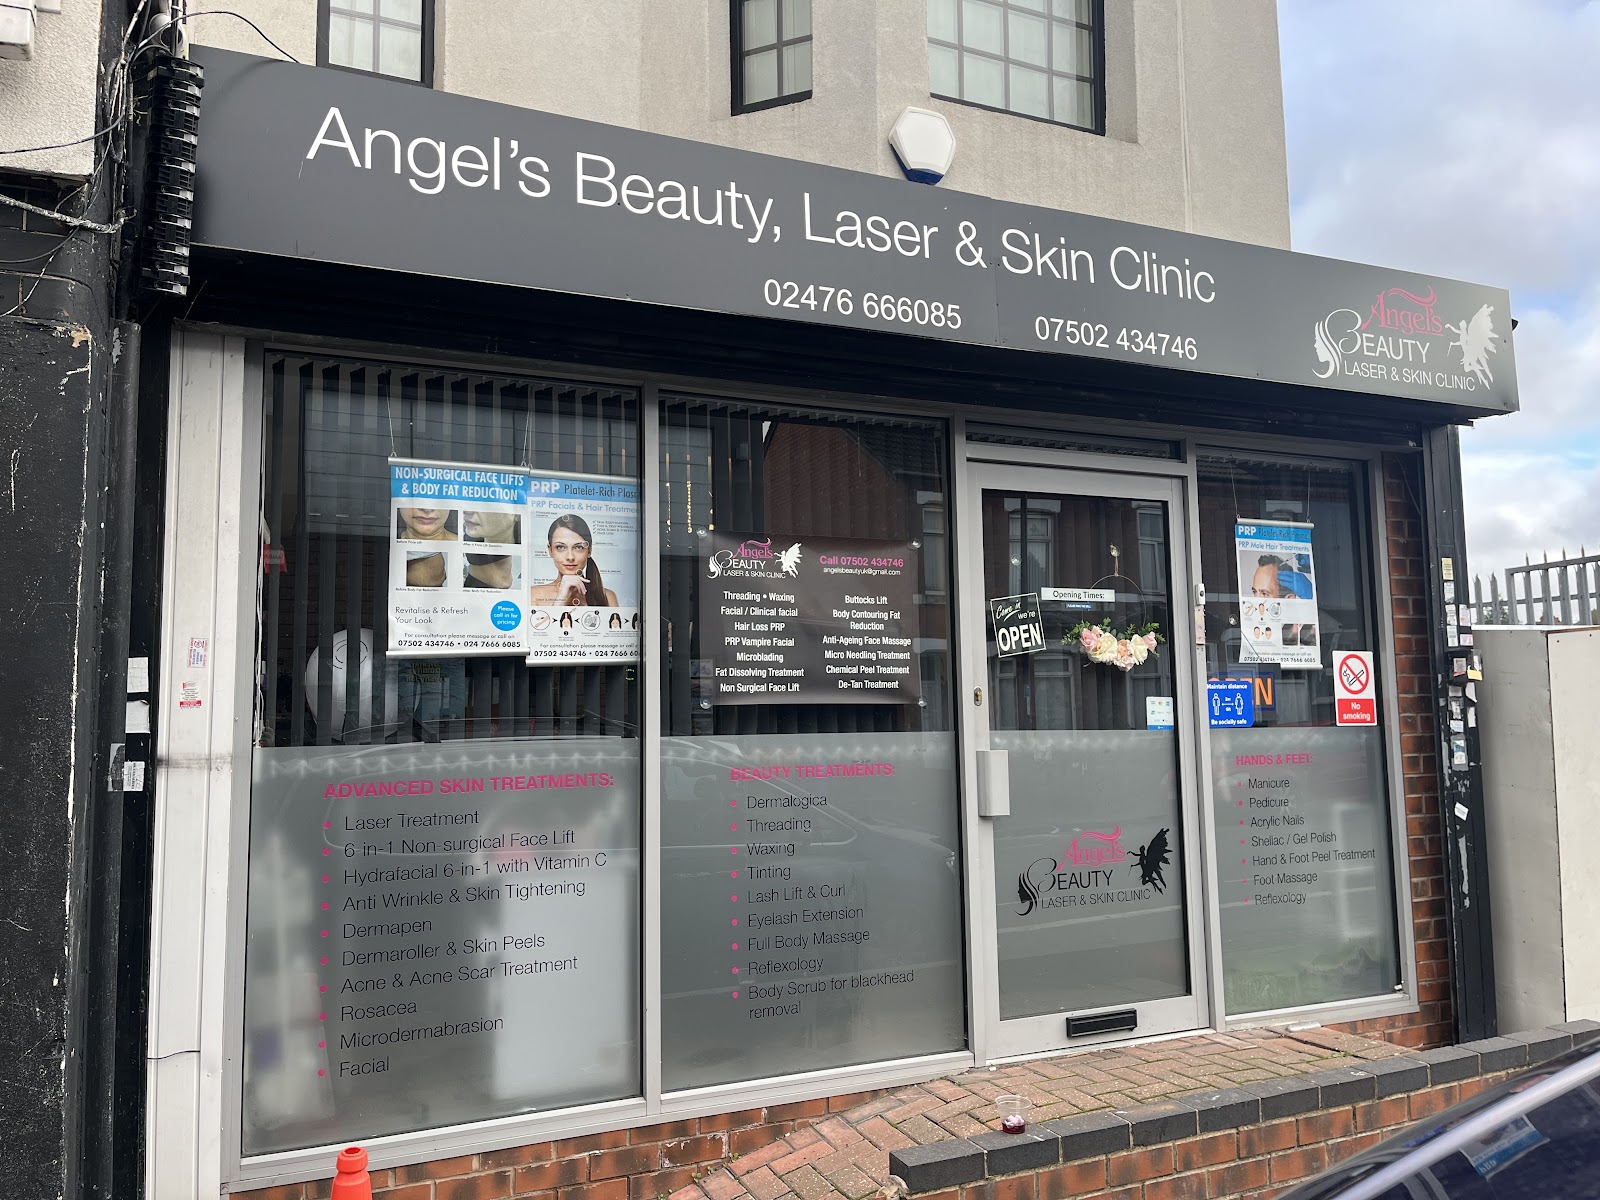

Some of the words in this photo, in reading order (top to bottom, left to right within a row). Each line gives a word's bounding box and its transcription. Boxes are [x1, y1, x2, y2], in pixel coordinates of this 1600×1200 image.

[305, 106, 551, 196] Angel's
[575, 151, 781, 244] Beauty,
[803, 192, 939, 260] Laser
[955, 220, 988, 269] &
[1001, 227, 1096, 284] Skin
[1109, 245, 1216, 304] Clinic
[763, 278, 854, 315] 02476
[862, 291, 963, 330] 666085
[1034, 315, 1110, 349] 07502
[1115, 327, 1198, 361] 434746
[1344, 360, 1387, 380] LASER
[1391, 367, 1400, 381] &
[1402, 369, 1432, 386] SKIN
[1436, 372, 1475, 391] CLINIC
[395, 467, 472, 482] NON-SURGICAL
[475, 471, 497, 483] FACE
[501, 473, 524, 486] LIFTS
[413, 483, 440, 495] BODY
[443, 485, 459, 496] FAT
[462, 486, 518, 500] REDUCTION
[530, 481, 560, 493] PRP
[564, 484, 615, 497] Platelet-Rich
[1238, 526, 1256, 535] PRP
[819, 556, 838, 565] Call
[841, 556, 868, 566] 07502
[871, 557, 904, 567] 434746
[823, 567, 901, 576] angelsbeautyuk@gmail.com
[723, 591, 761, 602] Threading
[769, 592, 794, 603] Waxing
[845, 595, 875, 604] Buttocks
[876, 596, 888, 605] Lift
[1053, 591, 1081, 599] Opening
[1083, 591, 1104, 599] Times:
[441, 607, 468, 615] Refresh
[720, 606, 743, 615] Facial
[750, 607, 776, 616] Clinical
[778, 608, 798, 617] facial
[833, 610, 850, 620] Body
[851, 610, 888, 621] Contouring
[890, 611, 900, 620] Fat
[996, 605, 1013, 619] Come
[1015, 600, 1021, 609] in
[1018, 610, 1035, 619] we're
[734, 622, 750, 631] Hair
[751, 622, 768, 631] Loss
[770, 623, 785, 631] PRP
[850, 622, 884, 630] Reduction
[725, 637, 740, 646] PRP
[741, 638, 771, 648] Vampire
[773, 638, 794, 647] Facial
[823, 636, 863, 646] Anti-Ageing
[864, 636, 881, 645] Face
[883, 637, 911, 647] Massage
[998, 623, 1042, 651] OPEN
[736, 653, 784, 663] Microblading
[825, 651, 845, 660] Micro
[846, 651, 876, 661] Needling
[878, 651, 910, 660] Treatment
[715, 668, 727, 676] Fat
[729, 668, 767, 678] Dissolving
[768, 668, 804, 677] Treatment
[826, 665, 858, 674] Chemical
[860, 666, 875, 674] Peel
[877, 666, 909, 674] Treatment
[720, 683, 735, 692] Non
[737, 683, 767, 693] Surgical
[769, 683, 786, 692] Face
[787, 683, 800, 692] Lift
[838, 680, 863, 689] De-Tan
[865, 680, 899, 689] Treatment
[1351, 702, 1360, 710] No
[1343, 712, 1370, 722] smoking
[1236, 754, 1273, 766] HANDS
[1286, 753, 1313, 764] FEET:
[730, 766, 792, 781] BEAUTY
[796, 763, 896, 778] TREATMENTS:
[323, 780, 434, 799] ADVANCED
[439, 778, 485, 795] SKIN
[490, 773, 614, 792] TREATMENTS:
[1249, 778, 1290, 789] Manicure
[747, 794, 827, 809] Dermalogica
[1250, 797, 1289, 808] Pedicure
[345, 816, 392, 831] Laser
[397, 811, 479, 829] Treatment
[747, 819, 811, 833] Threading
[1251, 816, 1280, 829] Acrylic
[1283, 815, 1304, 825] Nails
[344, 841, 394, 858] 6-in-1
[402, 834, 505, 854] Non-surgical
[510, 832, 548, 847] Face
[553, 830, 575, 844] Lift
[1293, 833, 1308, 844] Gel
[1311, 832, 1336, 843] Polish
[747, 842, 795, 856] Waxing
[1253, 855, 1277, 866] Hand
[1290, 853, 1309, 863] Foot
[1312, 851, 1330, 862] Peel
[1333, 848, 1376, 861] Treatment
[344, 864, 438, 887] Hydrafacial
[443, 861, 490, 878] 6-in-1
[497, 858, 529, 874] with
[534, 853, 590, 871] Vitamin
[595, 852, 607, 867] C
[747, 866, 791, 880] Tinting
[1254, 875, 1274, 885] Foot
[1277, 872, 1318, 885] Massage
[343, 896, 376, 912] Anti
[383, 891, 444, 909] Wrinkle
[465, 886, 500, 902] Skin
[505, 881, 586, 901] Tightening
[747, 889, 779, 904] Lash
[784, 887, 803, 900] Lift
[820, 884, 846, 897] Curl
[1255, 892, 1307, 905] Reflexology
[748, 911, 798, 929] Eyelash
[802, 906, 864, 923] Extension
[343, 920, 432, 939] Dermapen
[748, 937, 770, 951] Full
[775, 934, 809, 949] Body
[813, 929, 870, 945] Massage
[342, 943, 440, 967] Dermaroller
[463, 938, 497, 954] Skin
[503, 934, 546, 951] Peels
[748, 957, 824, 975] Reflexology
[341, 976, 386, 994] Acne
[410, 969, 453, 987] Acne
[458, 964, 495, 981] Scar
[500, 956, 578, 977] Treatment
[749, 985, 783, 1000] Body
[787, 980, 827, 996] Scrub
[831, 977, 847, 991] for
[851, 969, 914, 988] blackhead
[341, 1001, 417, 1021] Rosacea
[750, 1000, 801, 1019] removal
[340, 1017, 504, 1050] Microdermabrasion
[339, 1056, 390, 1078] Facial
